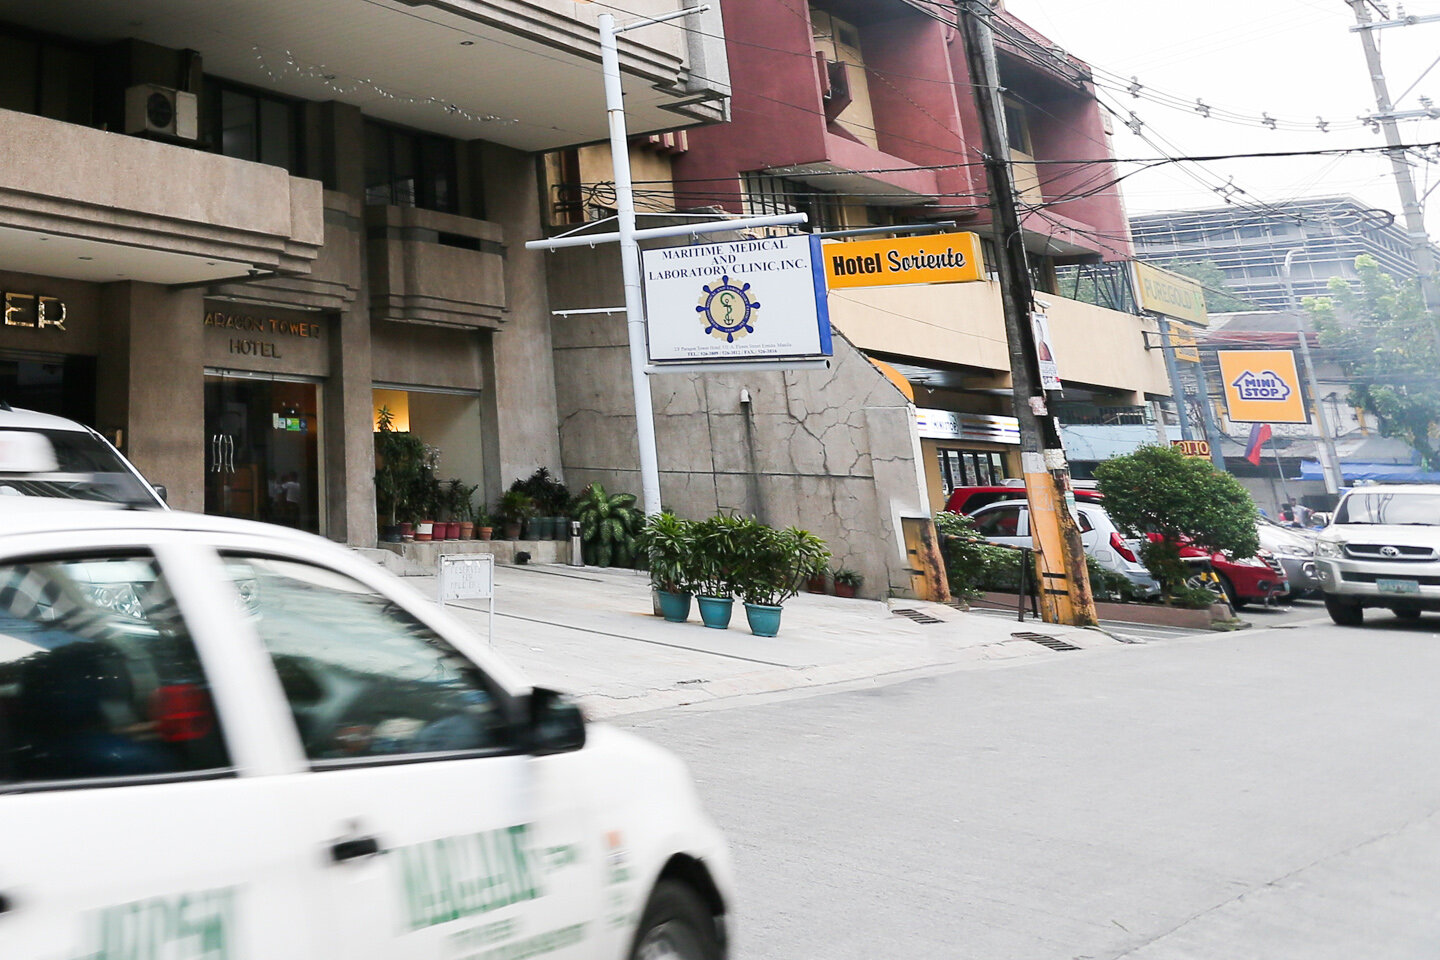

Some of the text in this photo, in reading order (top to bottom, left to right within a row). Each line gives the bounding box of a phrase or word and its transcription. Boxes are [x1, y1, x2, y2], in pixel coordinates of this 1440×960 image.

[662, 240, 788, 260] MARITIME MEDICAL
[711, 254, 737, 265] AND
[832, 247, 966, 276] Hotel Soriente
[648, 265, 729, 281] LABORATORY
[1144, 278, 1192, 309] PUREGOLD
[203, 312, 320, 339] ARAGON TOWER
[229, 338, 281, 359] HOTEL
[1245, 379, 1276, 388] MINI
[1245, 388, 1279, 397] STOP
